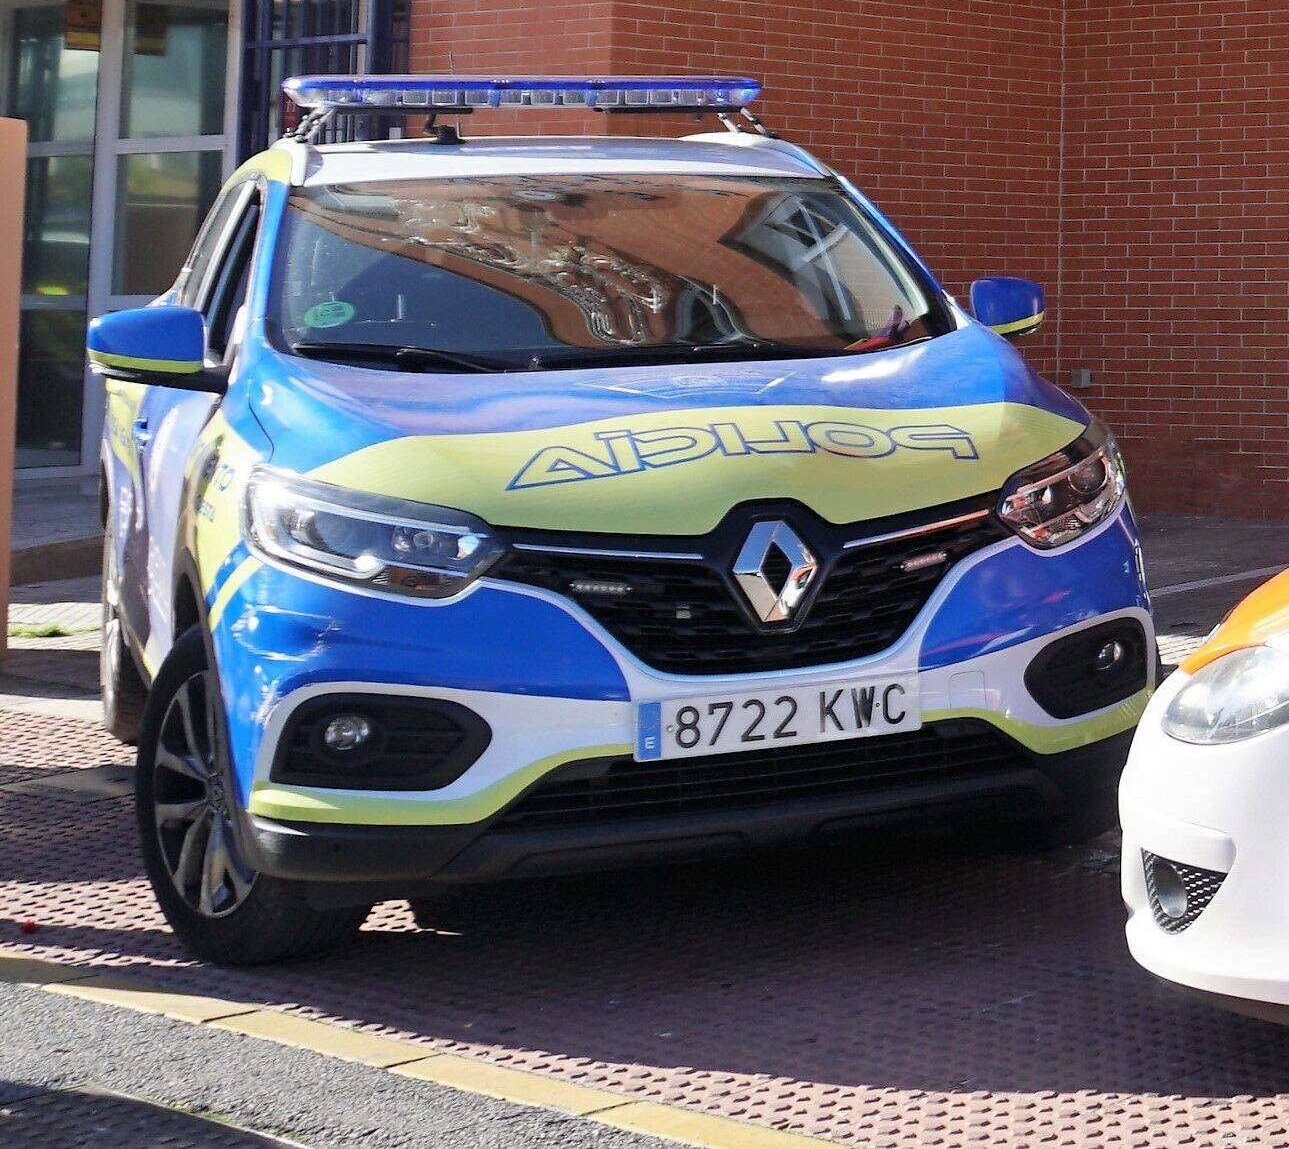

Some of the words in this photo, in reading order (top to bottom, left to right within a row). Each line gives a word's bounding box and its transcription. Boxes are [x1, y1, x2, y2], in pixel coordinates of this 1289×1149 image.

[675, 694, 798, 748] 8722
[819, 682, 906, 734] KWC
[645, 736, 656, 749] E
